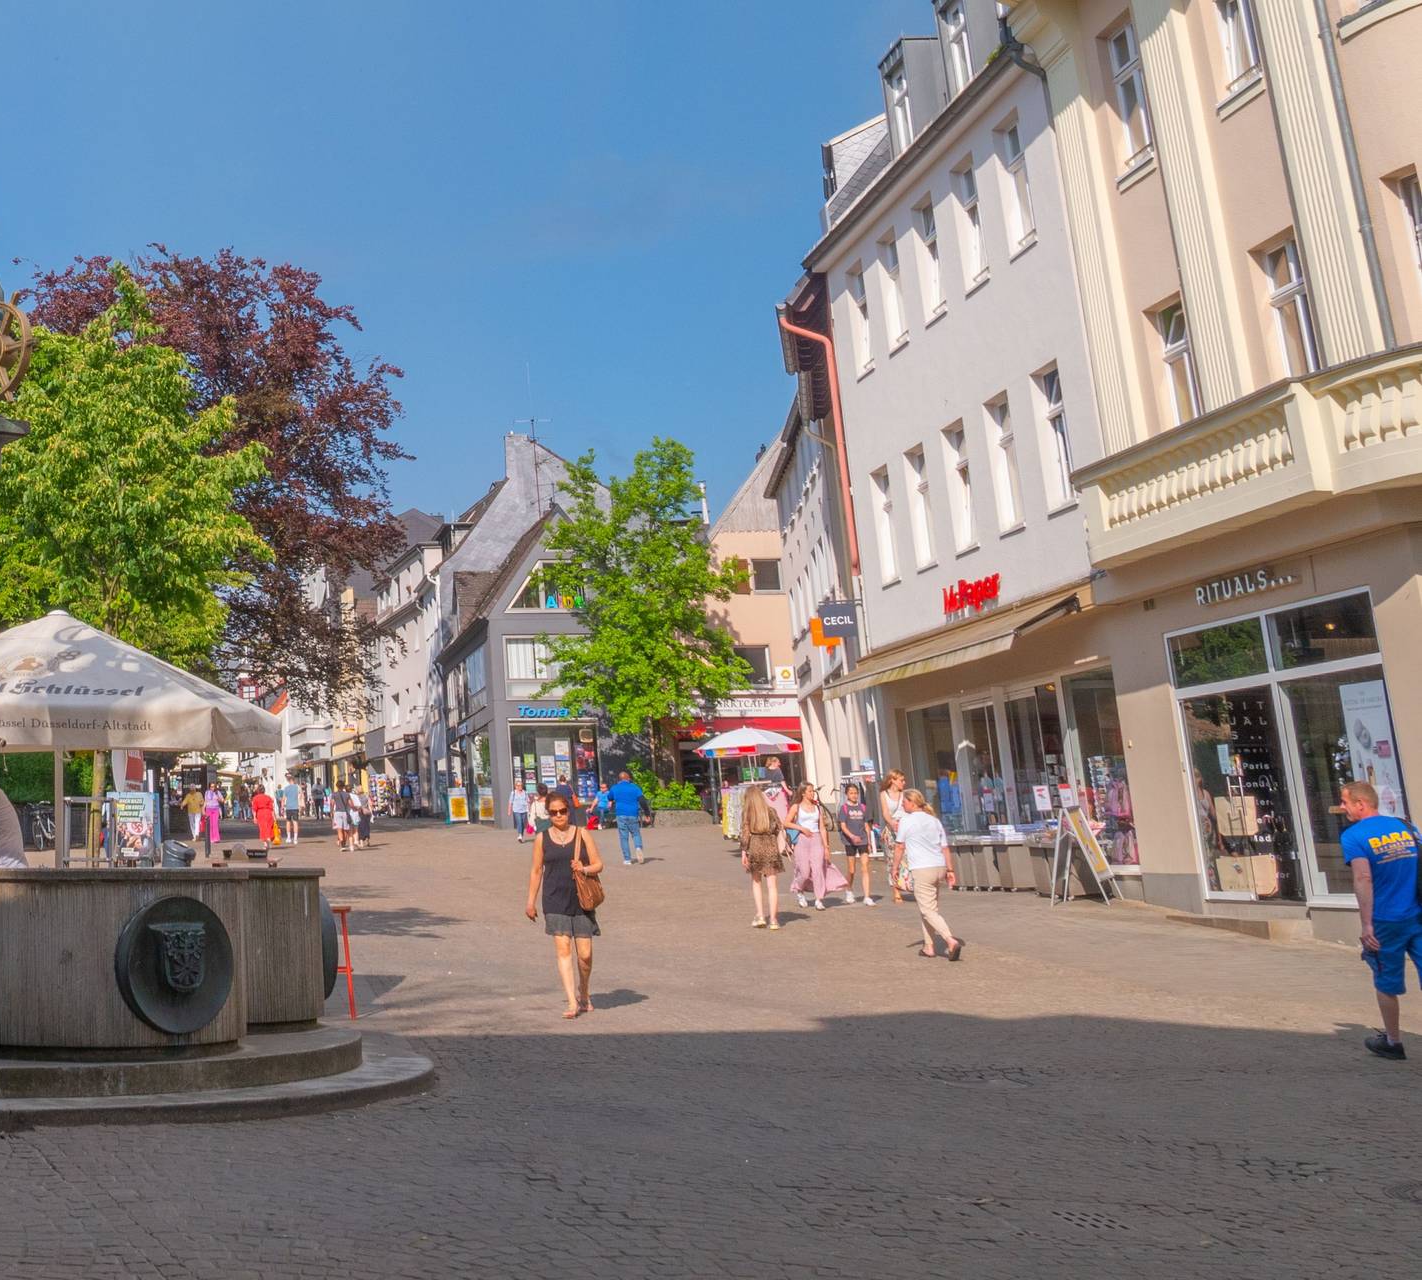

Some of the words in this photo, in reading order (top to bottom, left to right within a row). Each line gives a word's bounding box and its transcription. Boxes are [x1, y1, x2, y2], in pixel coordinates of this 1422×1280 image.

[823, 615, 854, 625] CECIL
[9, 678, 145, 697] Schlüssel
[31, 718, 154, 732] Düsseldorf-Altstadt
[1242, 762, 1271, 770] Paris
